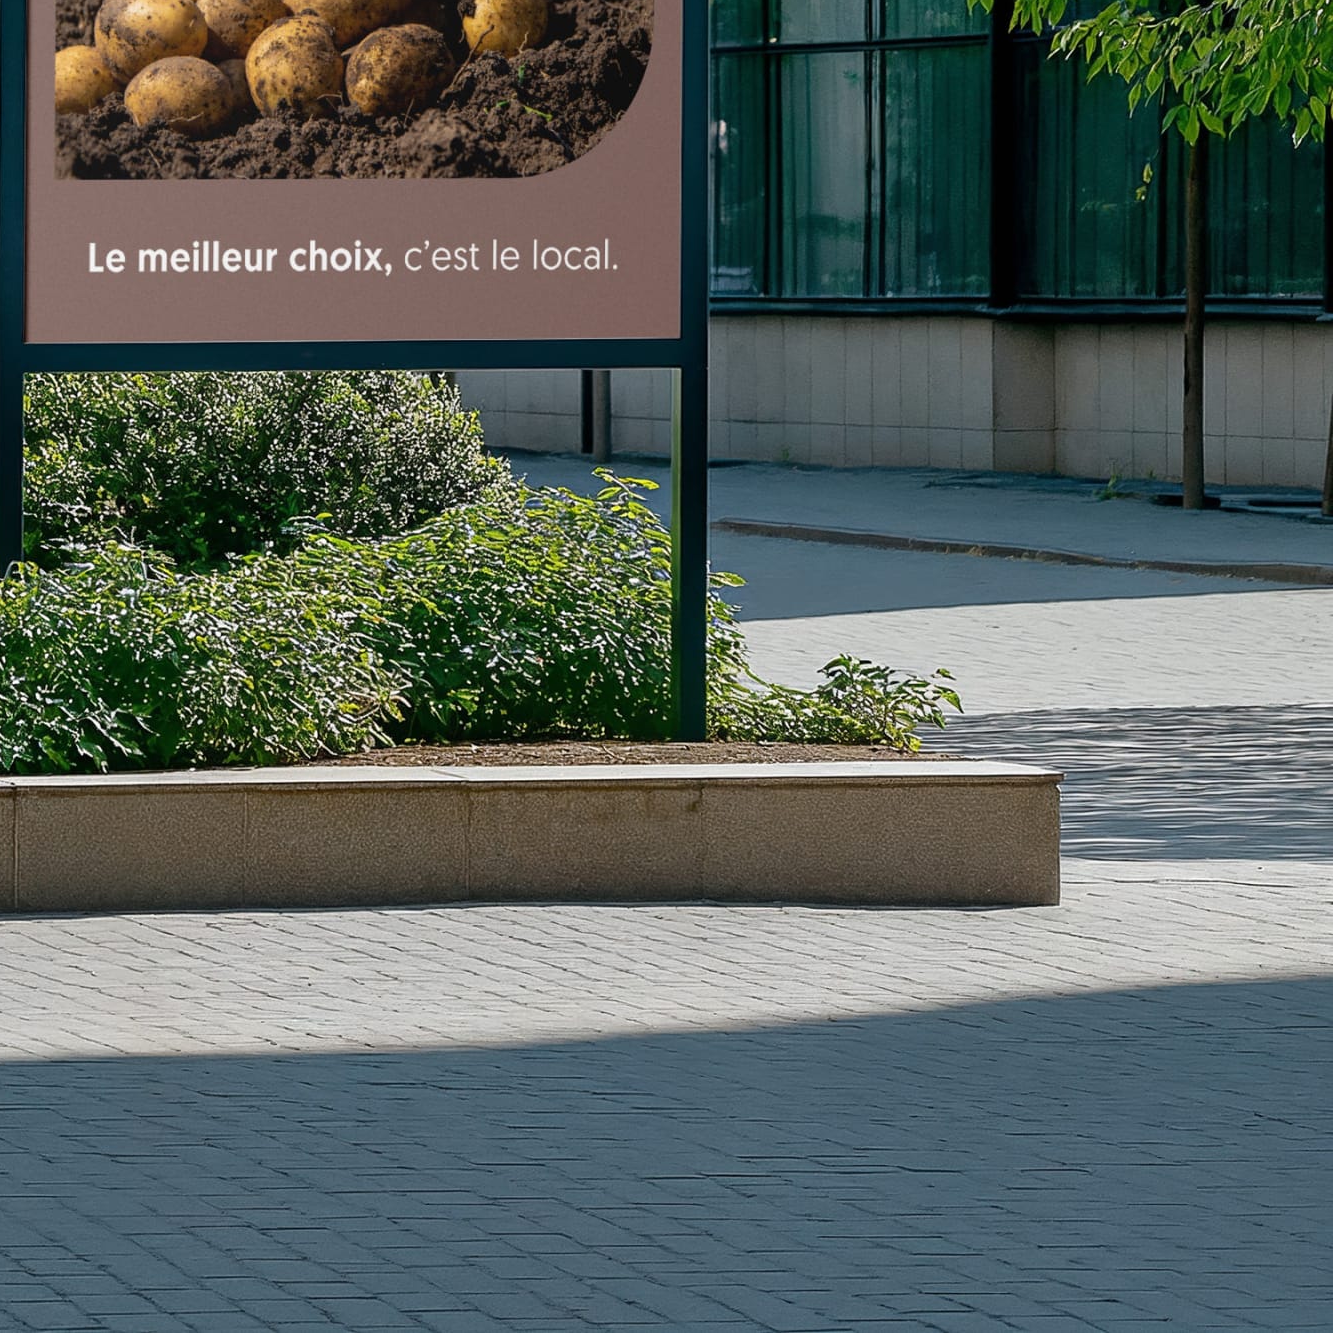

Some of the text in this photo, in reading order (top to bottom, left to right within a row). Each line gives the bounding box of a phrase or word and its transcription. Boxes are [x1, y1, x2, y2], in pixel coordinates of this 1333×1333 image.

[88, 242, 126, 274] Le
[138, 240, 278, 273] meilleur
[289, 239, 393, 277] choix,
[492, 238, 520, 271] le
[533, 238, 618, 271] local.
